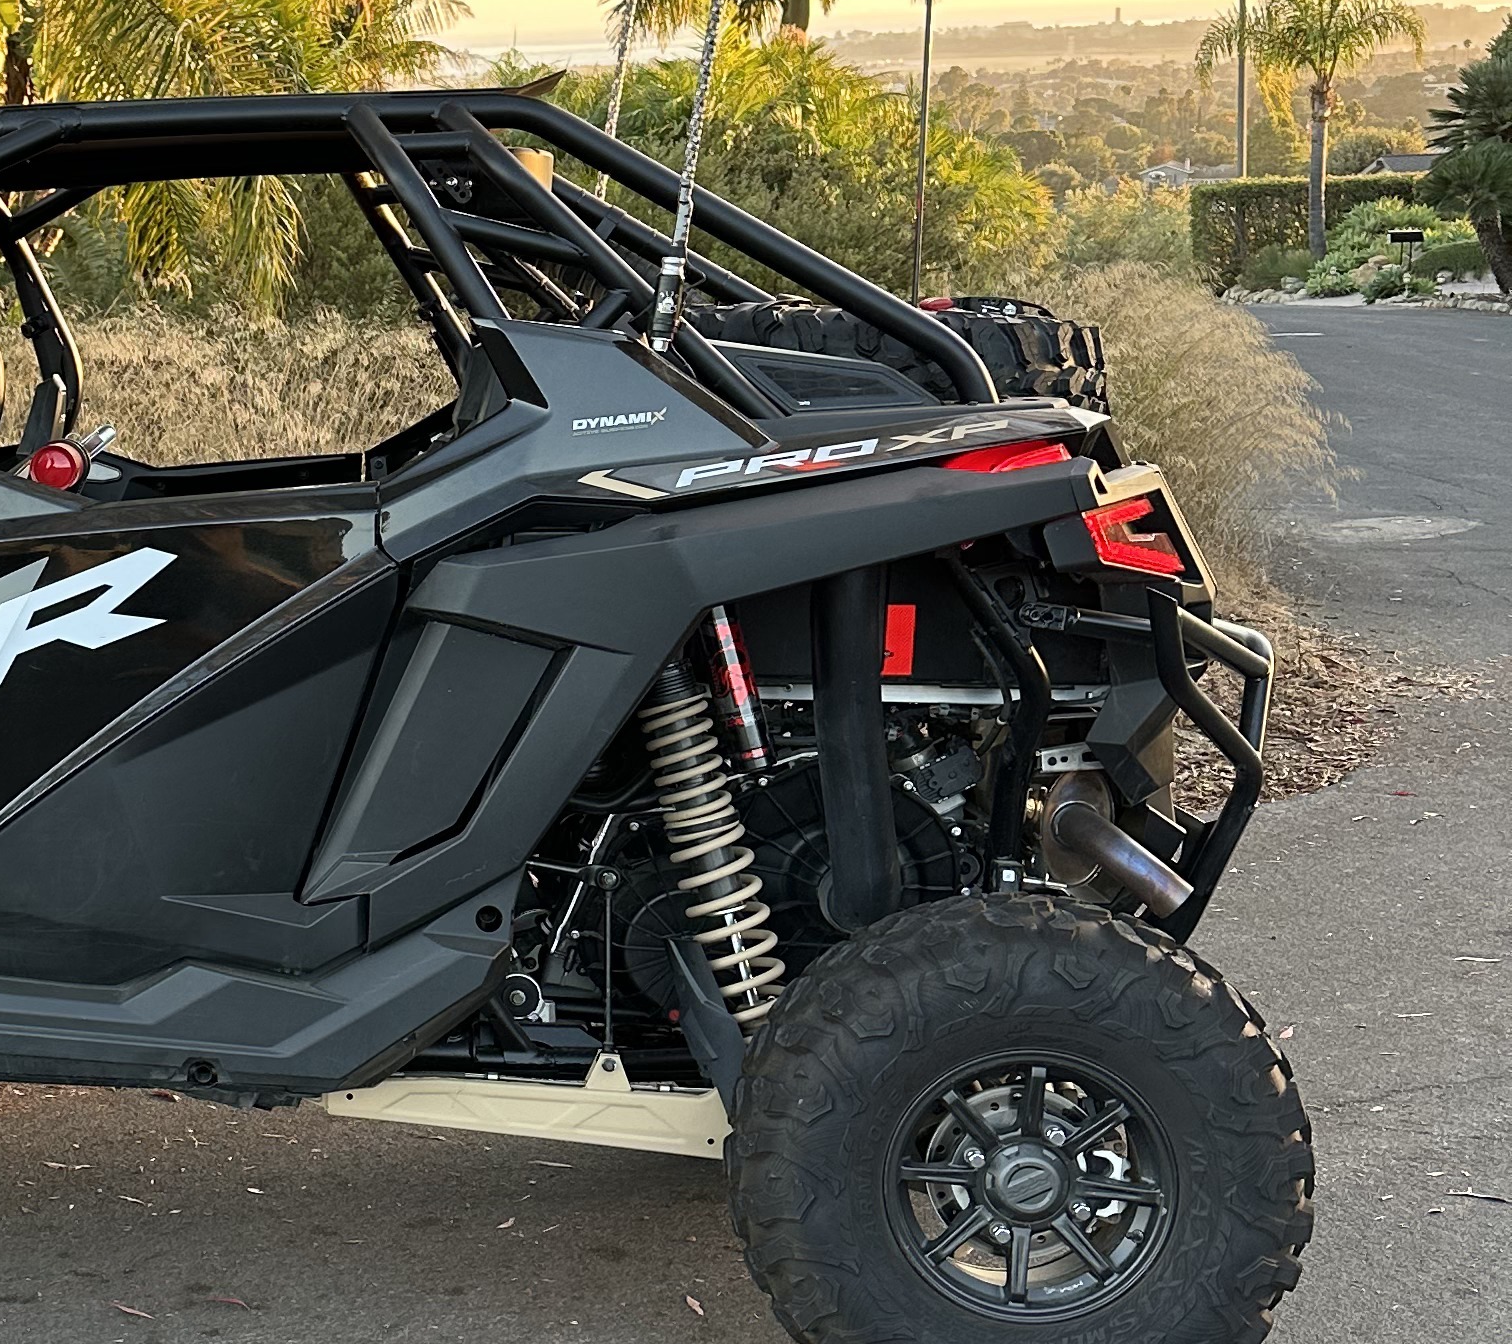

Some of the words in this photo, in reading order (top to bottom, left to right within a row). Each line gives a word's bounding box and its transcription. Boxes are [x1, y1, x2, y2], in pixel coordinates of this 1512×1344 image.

[572, 406, 667, 431] DYNAMIX
[675, 438, 879, 488] PRO
[885, 420, 1009, 452] XP
